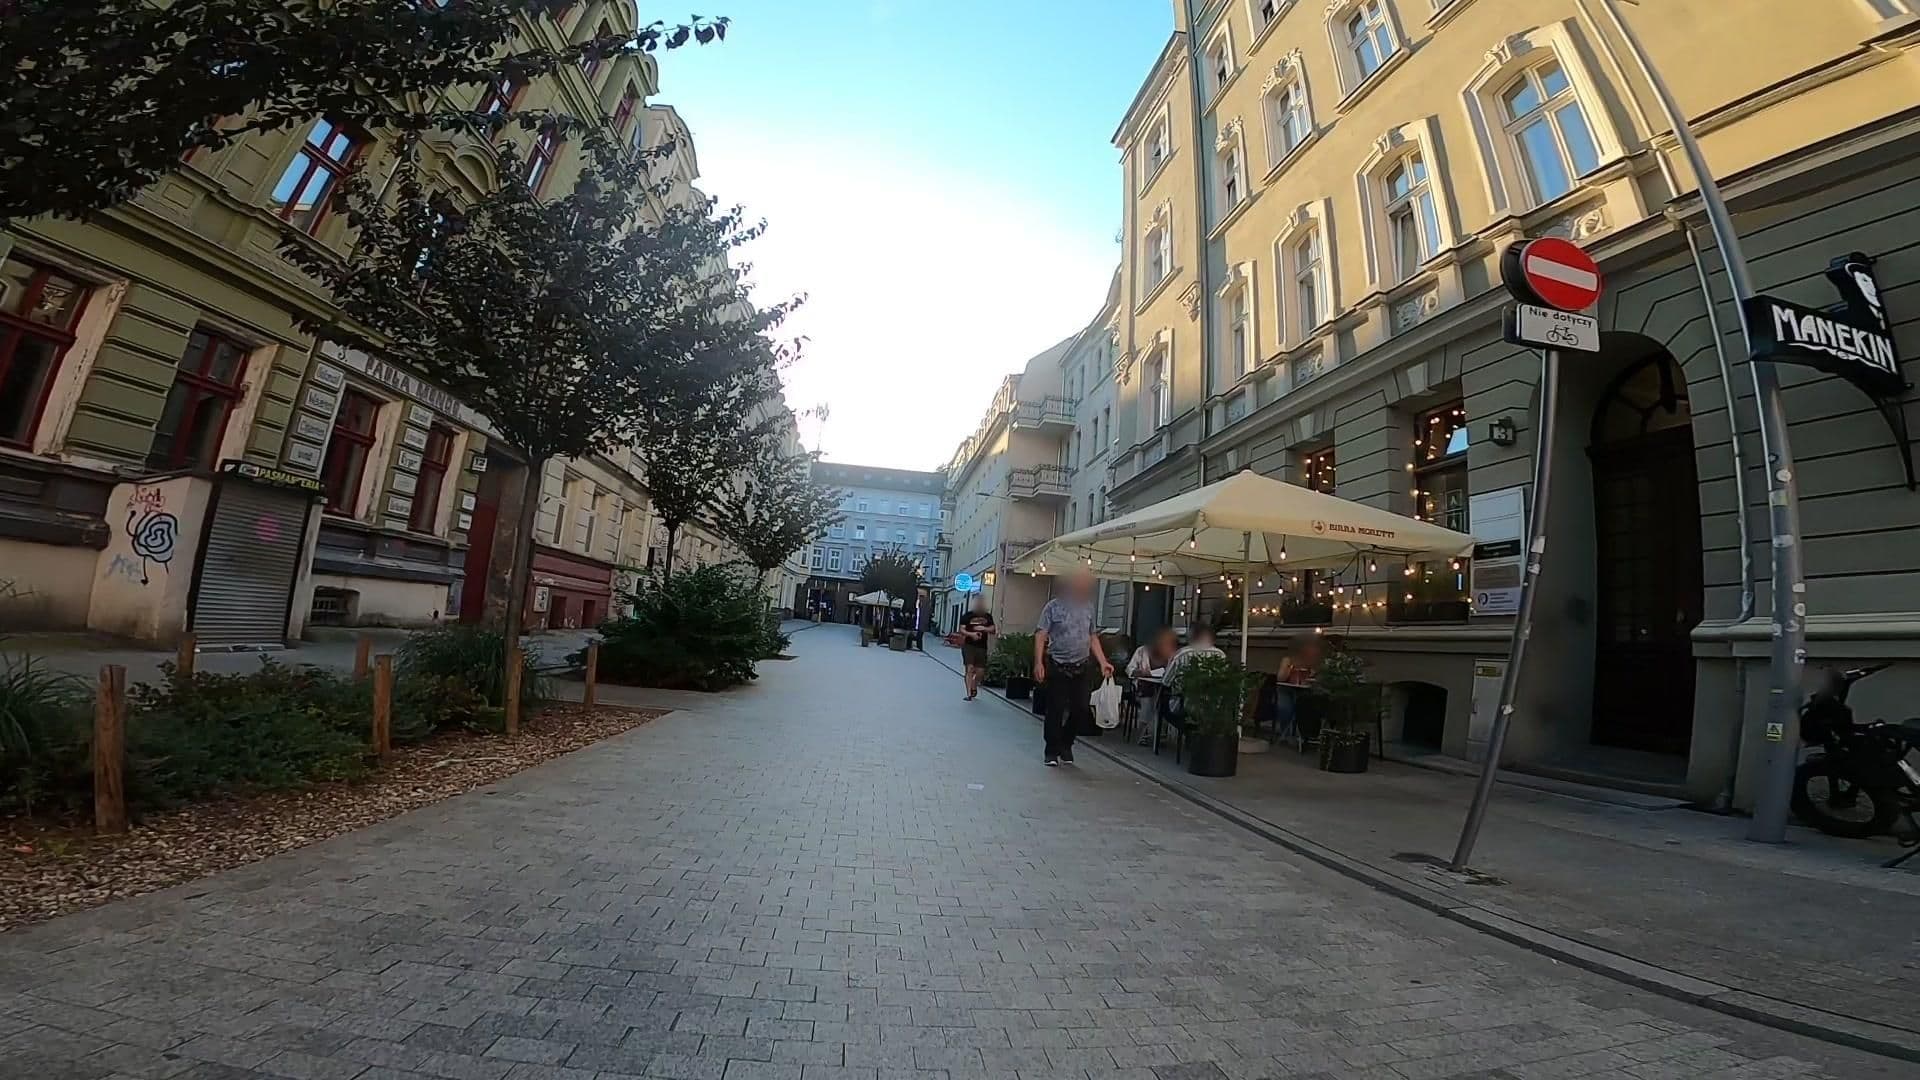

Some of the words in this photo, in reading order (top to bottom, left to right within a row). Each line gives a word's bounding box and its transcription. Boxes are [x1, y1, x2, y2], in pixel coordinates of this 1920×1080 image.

[1529, 307, 1548, 318] Nie
[1553, 311, 1592, 329] dotyczy
[1771, 303, 1899, 376] MANEKIN
[1329, 523, 1356, 534] BIRRA
[1358, 527, 1395, 539] MORETTI
